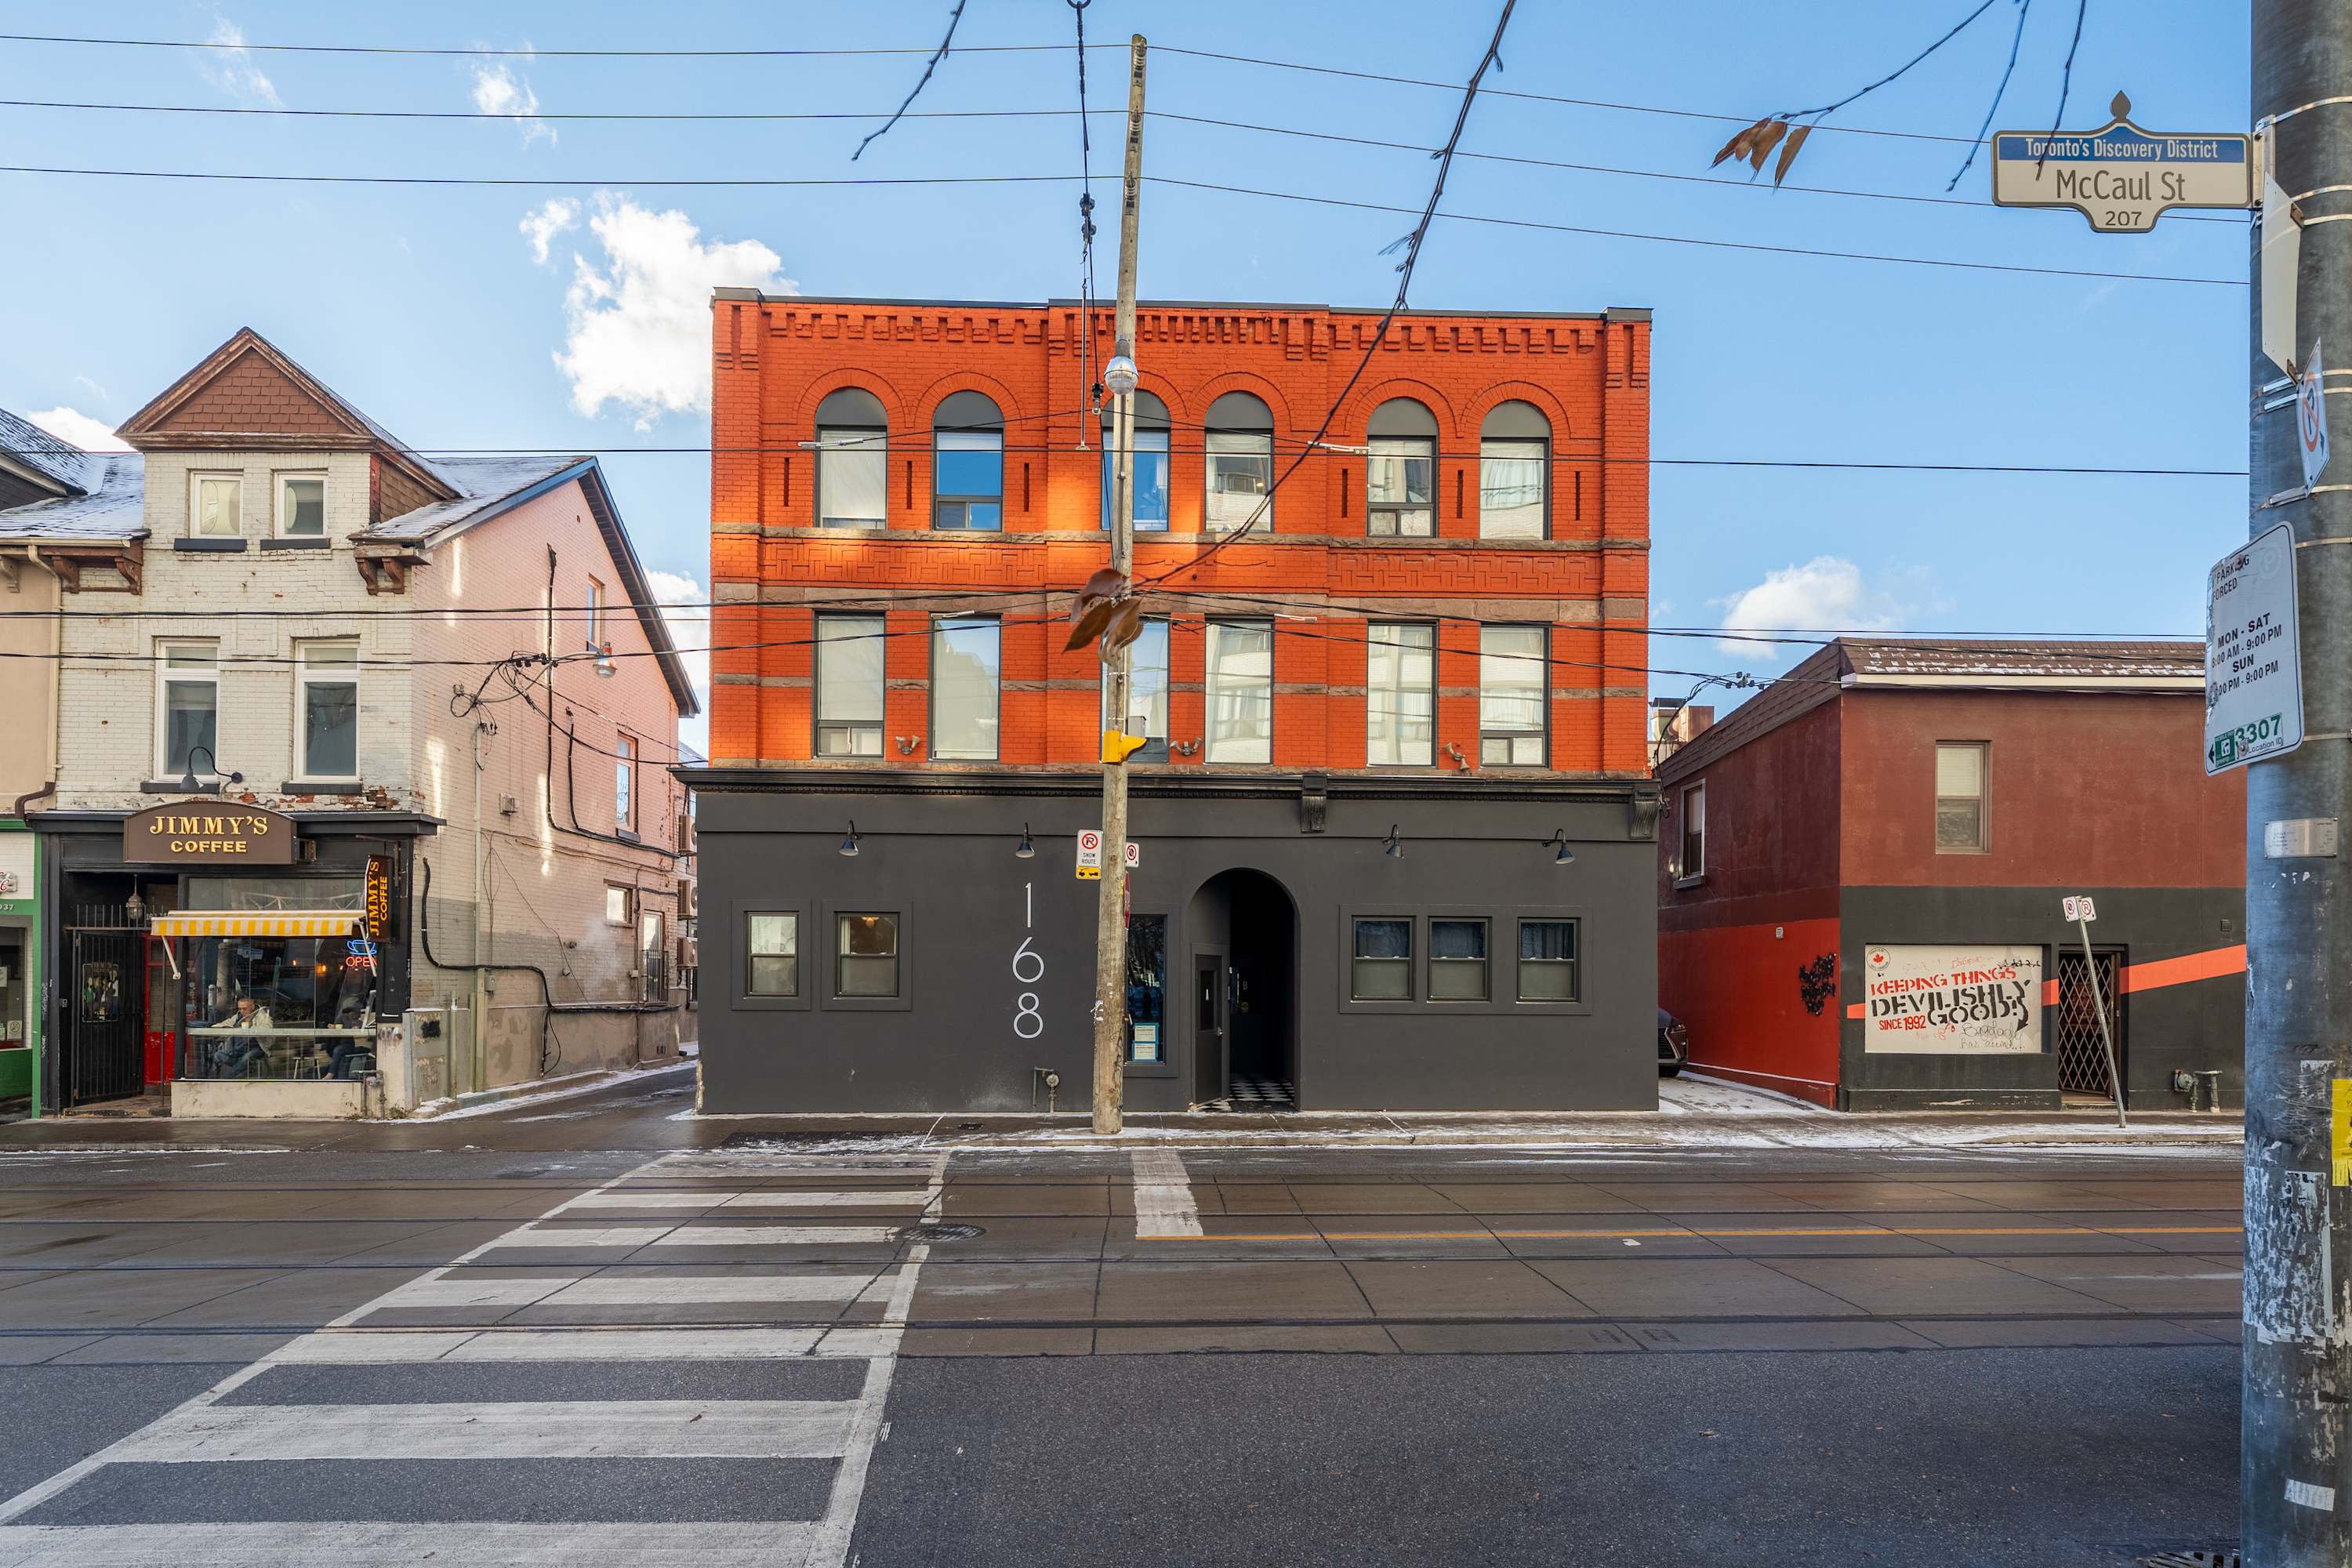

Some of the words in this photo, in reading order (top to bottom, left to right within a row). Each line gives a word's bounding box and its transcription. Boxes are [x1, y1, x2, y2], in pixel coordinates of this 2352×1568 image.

[2025, 138, 2090, 158] Toronto's
[2094, 139, 2162, 162] Discovery
[2167, 140, 2219, 158] District
[2056, 169, 2152, 201] McCaul
[2161, 171, 2186, 201] St
[2105, 210, 2142, 227] 207
[2216, 554, 2250, 585] PARKG
[2217, 628, 2239, 649] MON
[2248, 612, 2270, 633] SAT
[2227, 644, 2240, 661] AM
[2246, 633, 2266, 652] 9:00
[2267, 624, 2282, 641] PM
[2228, 677, 2240, 692] PM
[2245, 666, 2263, 684] 9:00
[2265, 660, 2279, 676] PM
[2232, 654, 2255, 673] SUN
[2235, 714, 2281, 746] 3307
[149, 815, 269, 836] JIMMY'S
[170, 840, 248, 853] COFFEE
[368, 861, 379, 937] JIMMY'S
[379, 876, 388, 921] COFFEE
[1012, 882, 1044, 1039] 168
[1870, 974, 1947, 996] KEEPING
[1951, 966, 2017, 986] THINGS
[1871, 979, 2031, 1018] DEVILISHLY
[1878, 1018, 1903, 1032] SINCE
[1903, 1015, 1927, 1032] 1992
